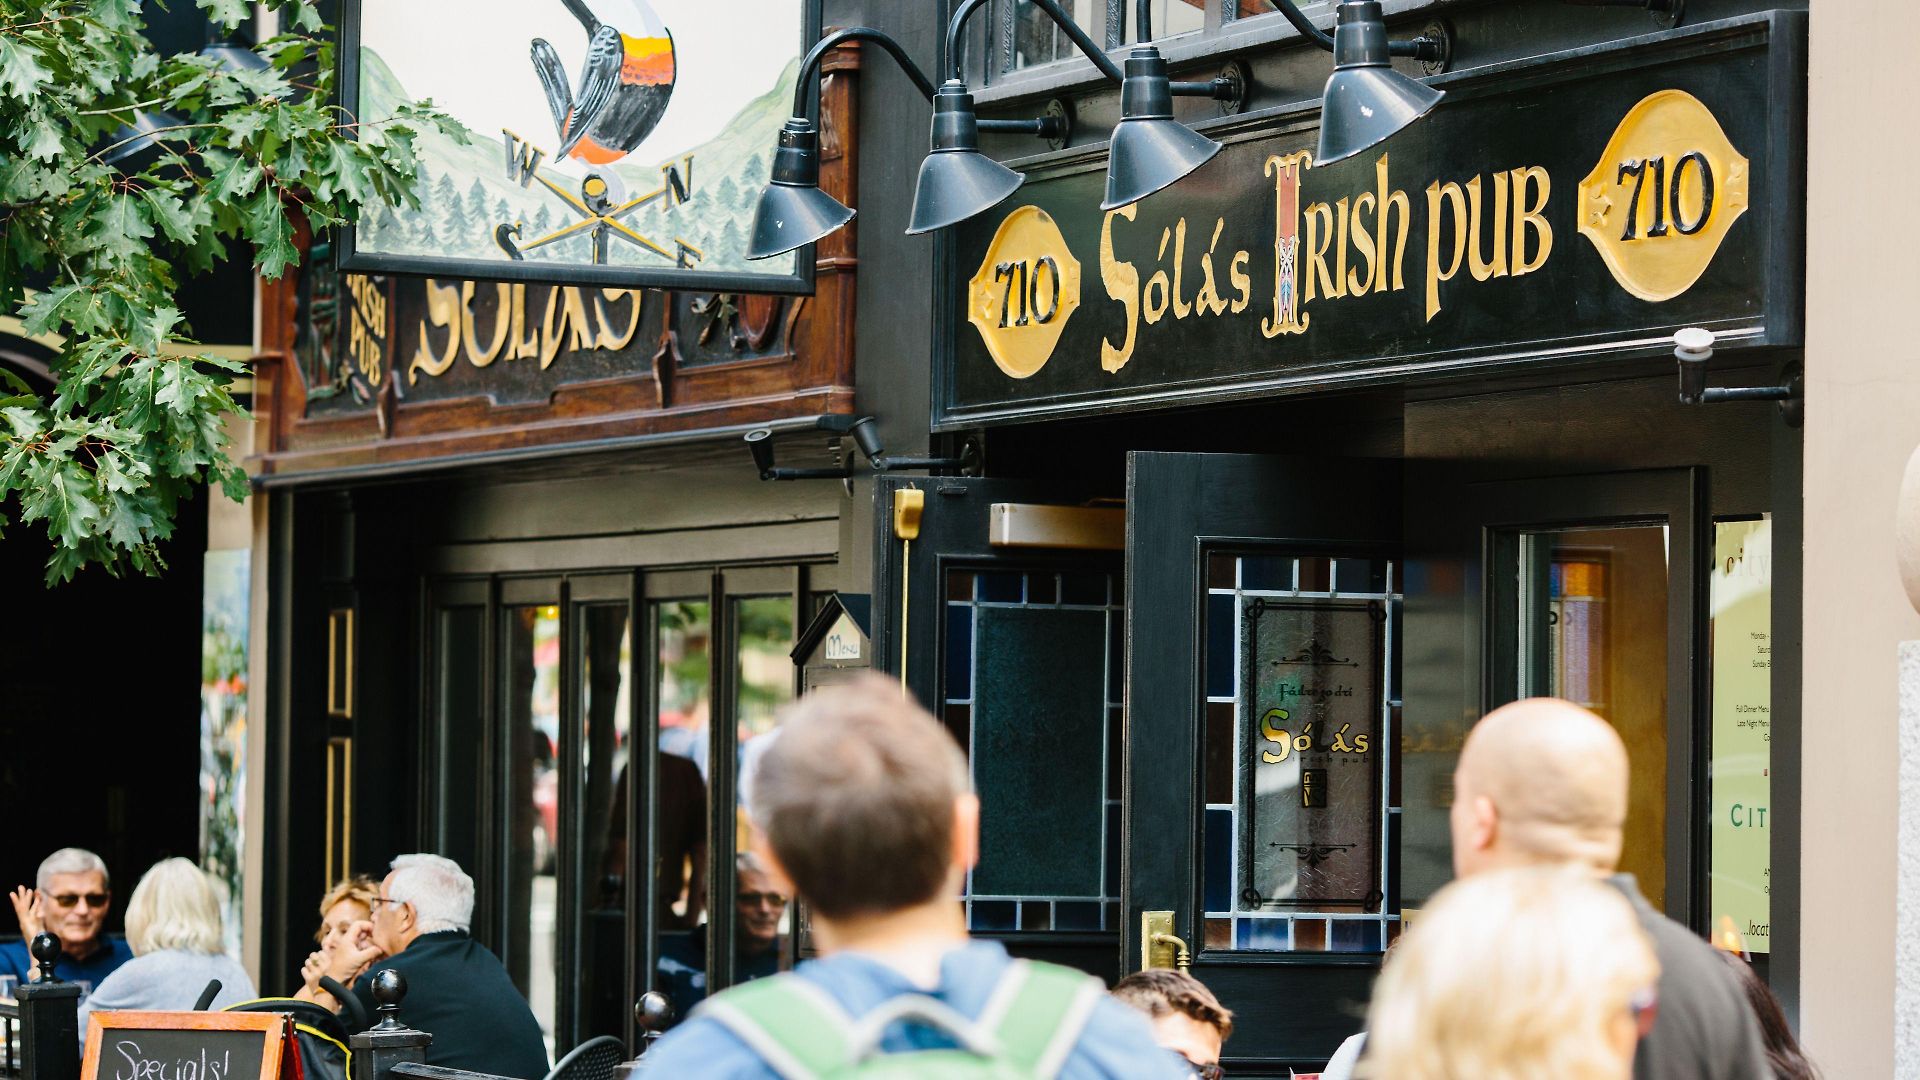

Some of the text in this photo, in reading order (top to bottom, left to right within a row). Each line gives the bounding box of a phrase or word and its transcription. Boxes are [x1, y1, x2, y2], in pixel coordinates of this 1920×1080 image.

[662, 153, 694, 213] N
[1616, 150, 1716, 242] 710
[995, 255, 1060, 329] 710
[350, 304, 382, 387] PUB
[1260, 707, 1369, 764] Sólás
